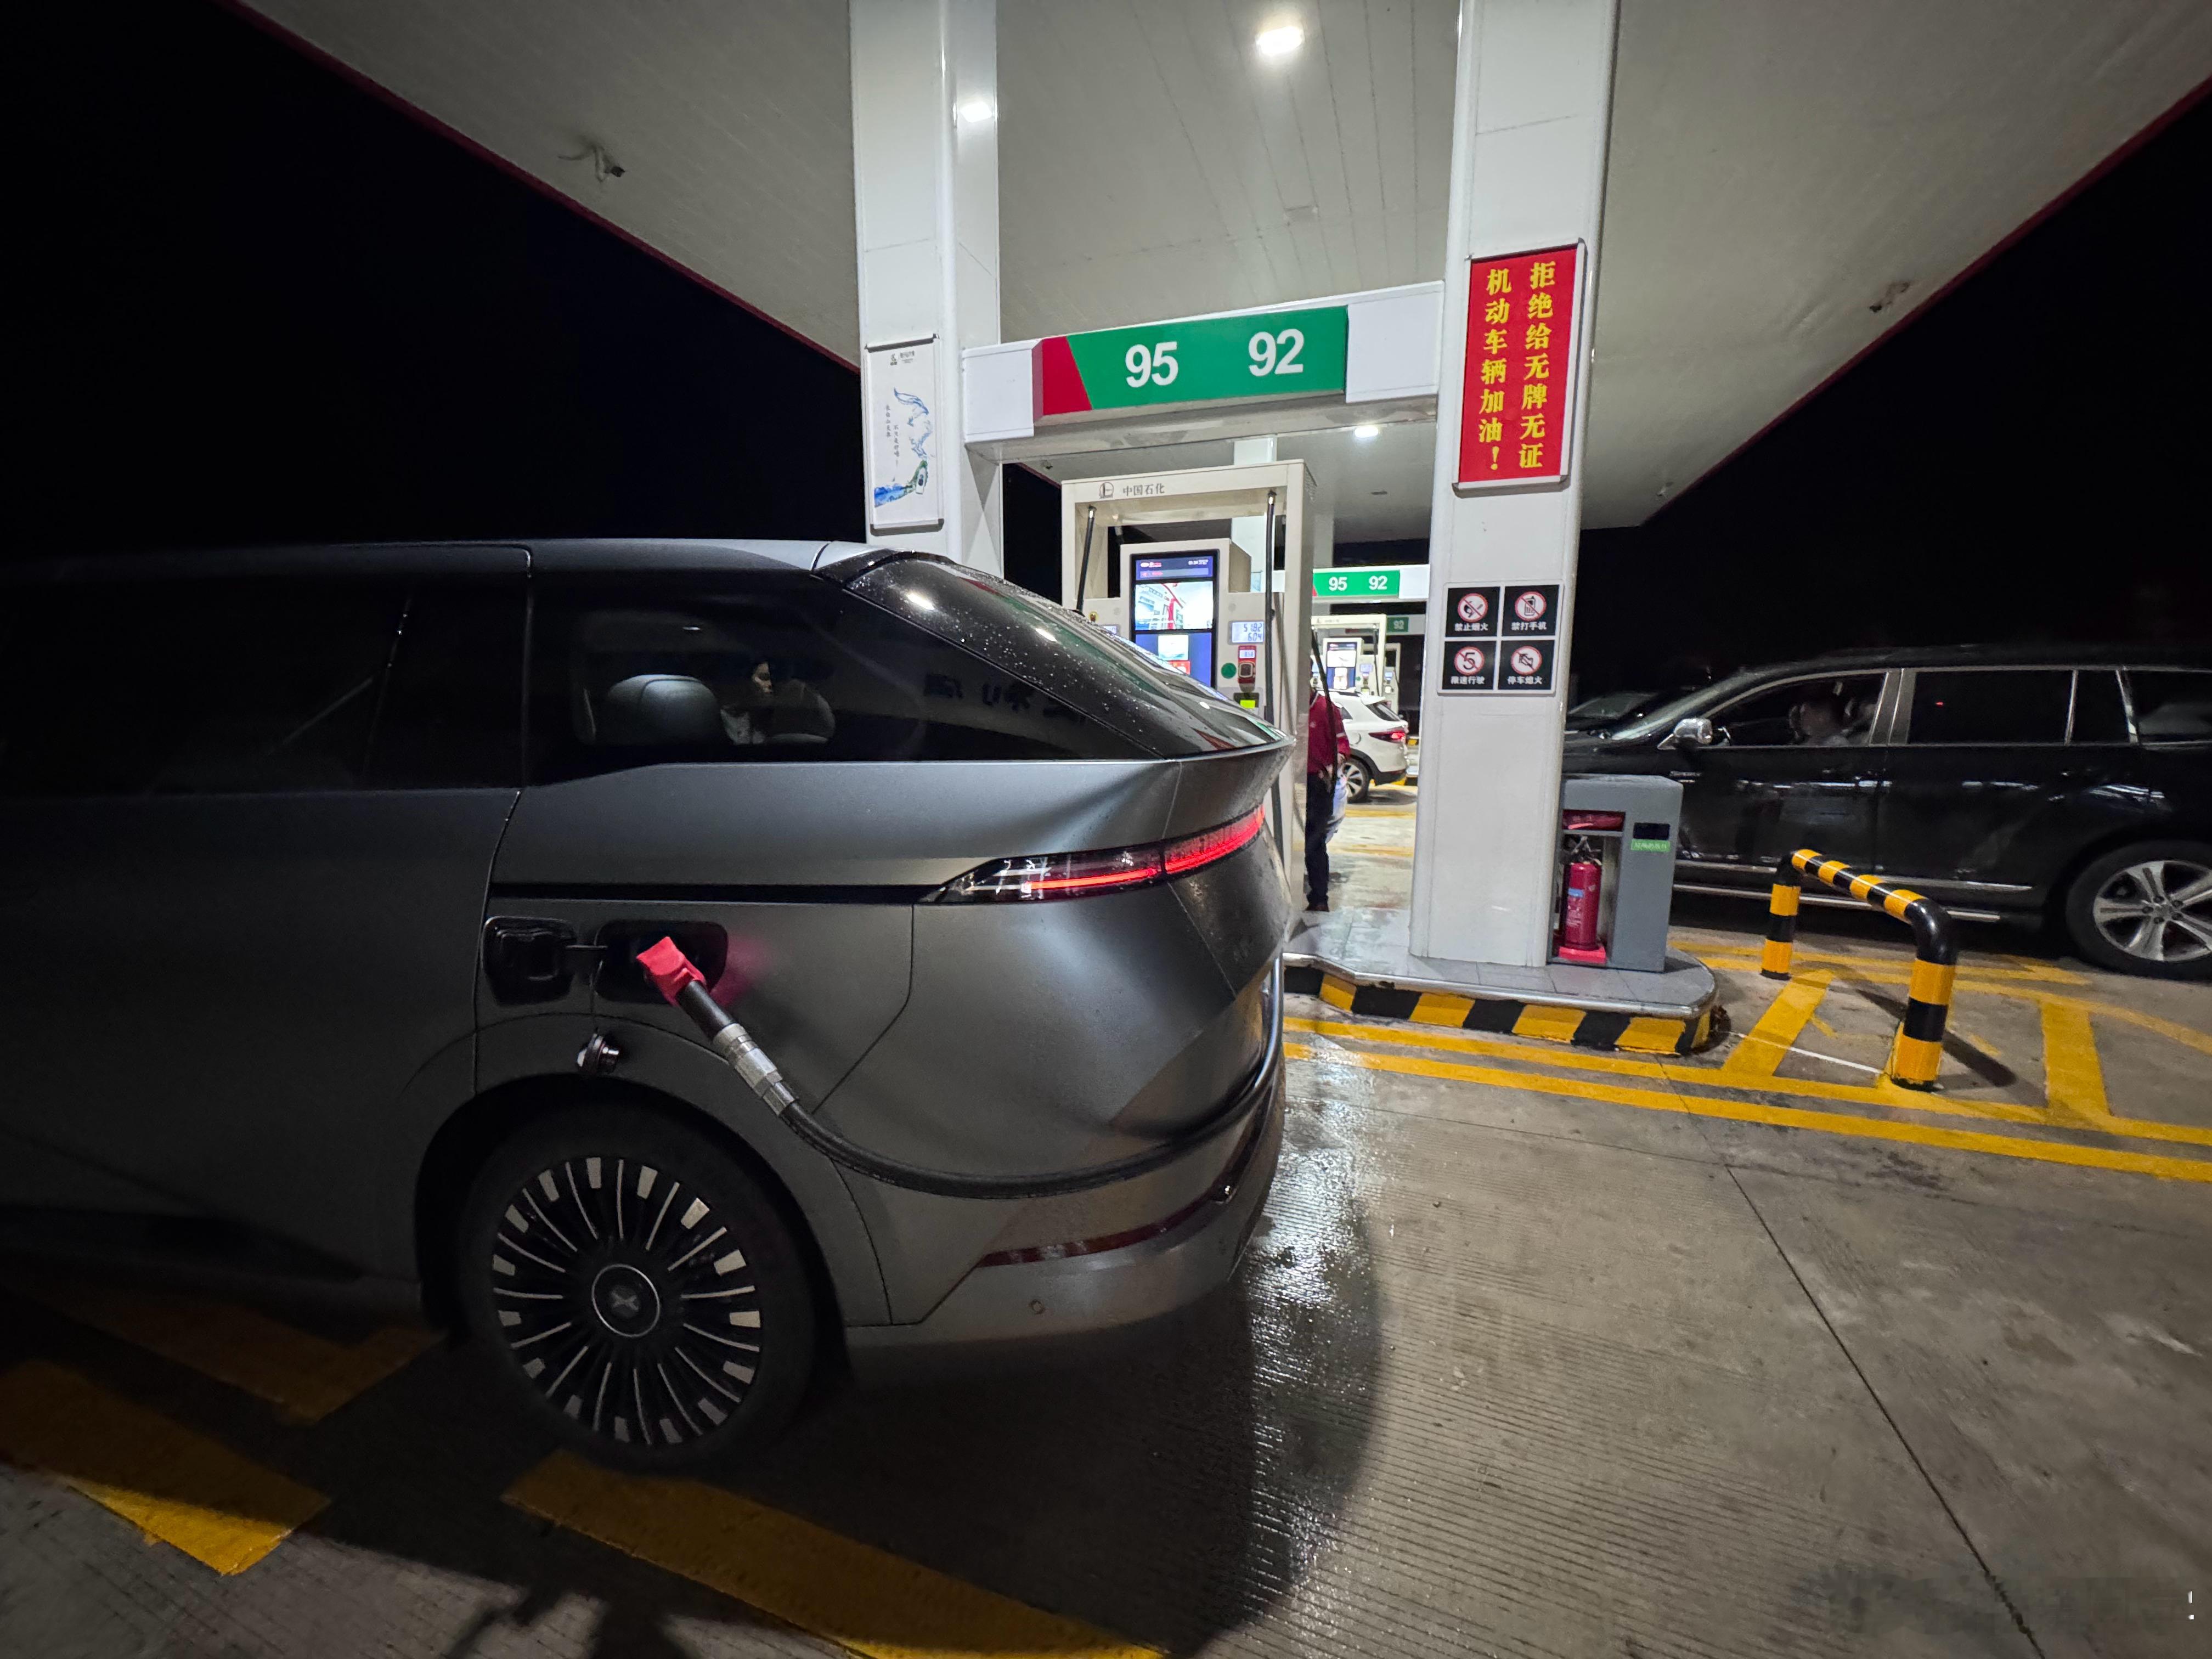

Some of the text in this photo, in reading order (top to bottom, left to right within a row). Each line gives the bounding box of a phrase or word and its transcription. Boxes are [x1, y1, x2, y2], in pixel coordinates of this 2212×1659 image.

[1125, 328, 1304, 388] 95 92
[1519, 261, 1556, 469] 拒绝给无牌无证
[1122, 483, 1165, 496] 中国石化
[1328, 575, 1388, 591] 95 92
[1454, 623, 1489, 631] 禁止烟火
[1511, 622, 1547, 631] 禁打手机
[1463, 652, 1476, 670] 5
[1451, 676, 1485, 685] 限速行驶
[1507, 675, 1543, 685] 停车熄火
